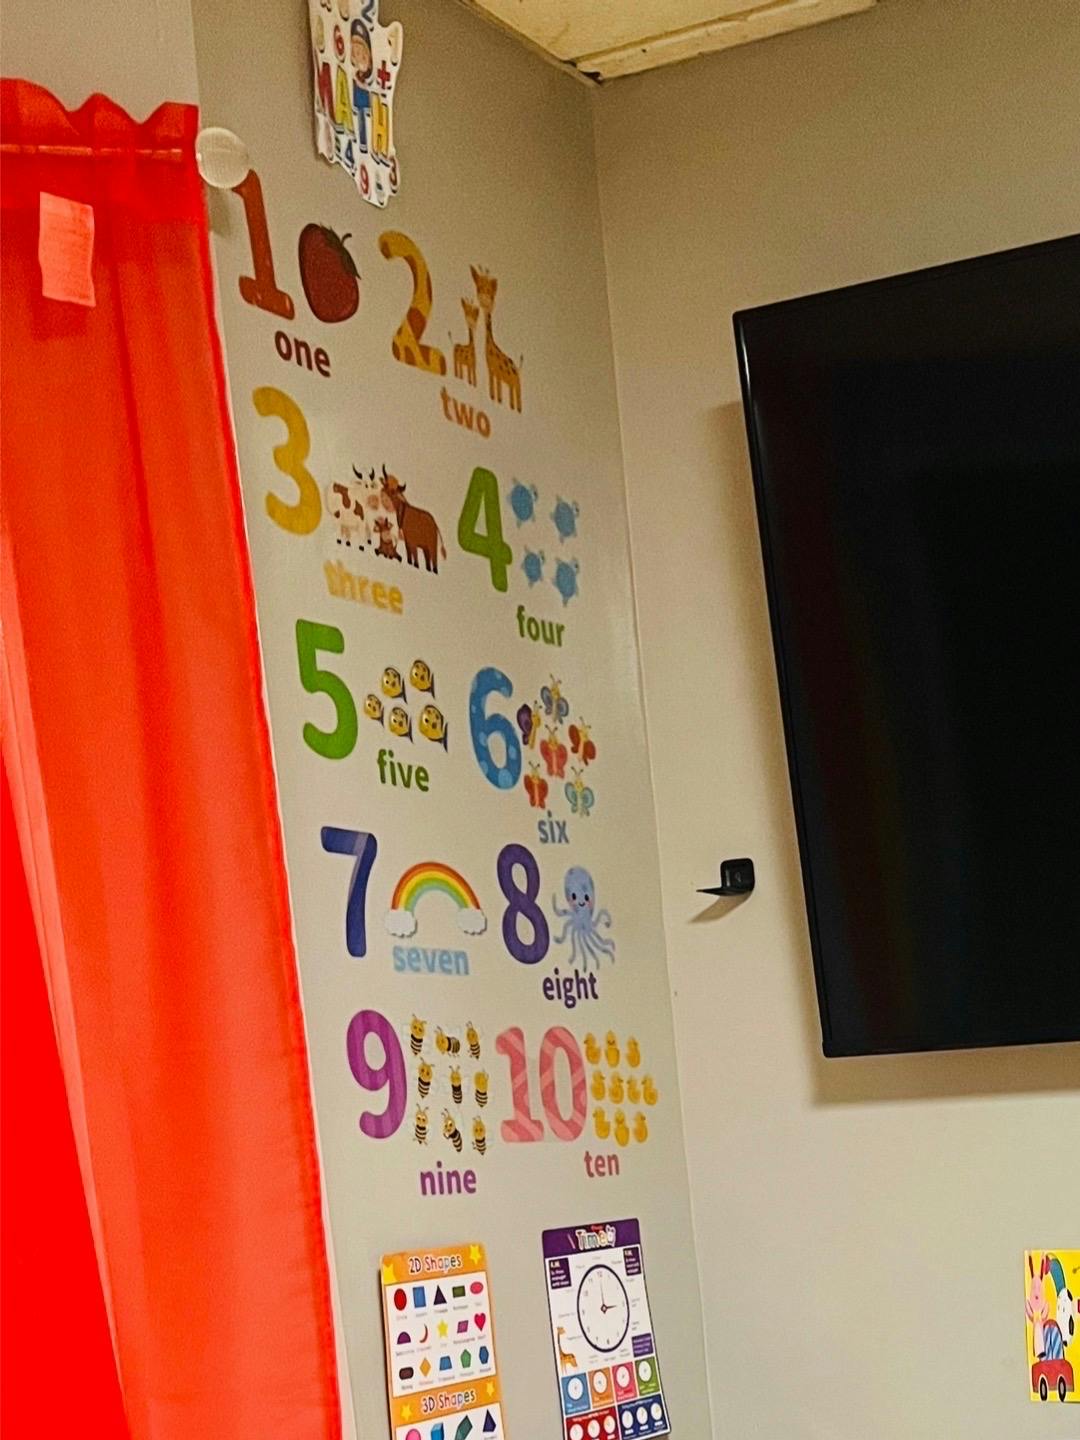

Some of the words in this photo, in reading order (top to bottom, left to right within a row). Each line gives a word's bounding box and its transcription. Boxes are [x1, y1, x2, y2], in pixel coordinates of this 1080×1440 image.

[231, 168, 296, 321] 1
[378, 230, 447, 376] 2
[274, 330, 331, 378] one
[440, 387, 491, 439] two
[252, 386, 322, 536] 3
[457, 466, 513, 593] 4
[323, 559, 403, 615] three
[516, 604, 565, 647] four
[296, 619, 358, 759] 5
[469, 666, 522, 790] 6
[377, 749, 429, 792] five
[537, 811, 569, 844] six
[320, 826, 377, 957] 7
[497, 843, 550, 965] 8
[393, 945, 470, 976] seven
[542, 970, 598, 1009] eight
[346, 1009, 407, 1139] 9
[495, 1026, 586, 1143] 10
[420, 1157, 477, 1196] nine
[584, 1151, 620, 1177] ten
[409, 1256, 422, 1274] 2D
[424, 1254, 462, 1273] Shapes
[422, 1396, 436, 1414] 3D
[439, 1390, 476, 1409] Shapes
